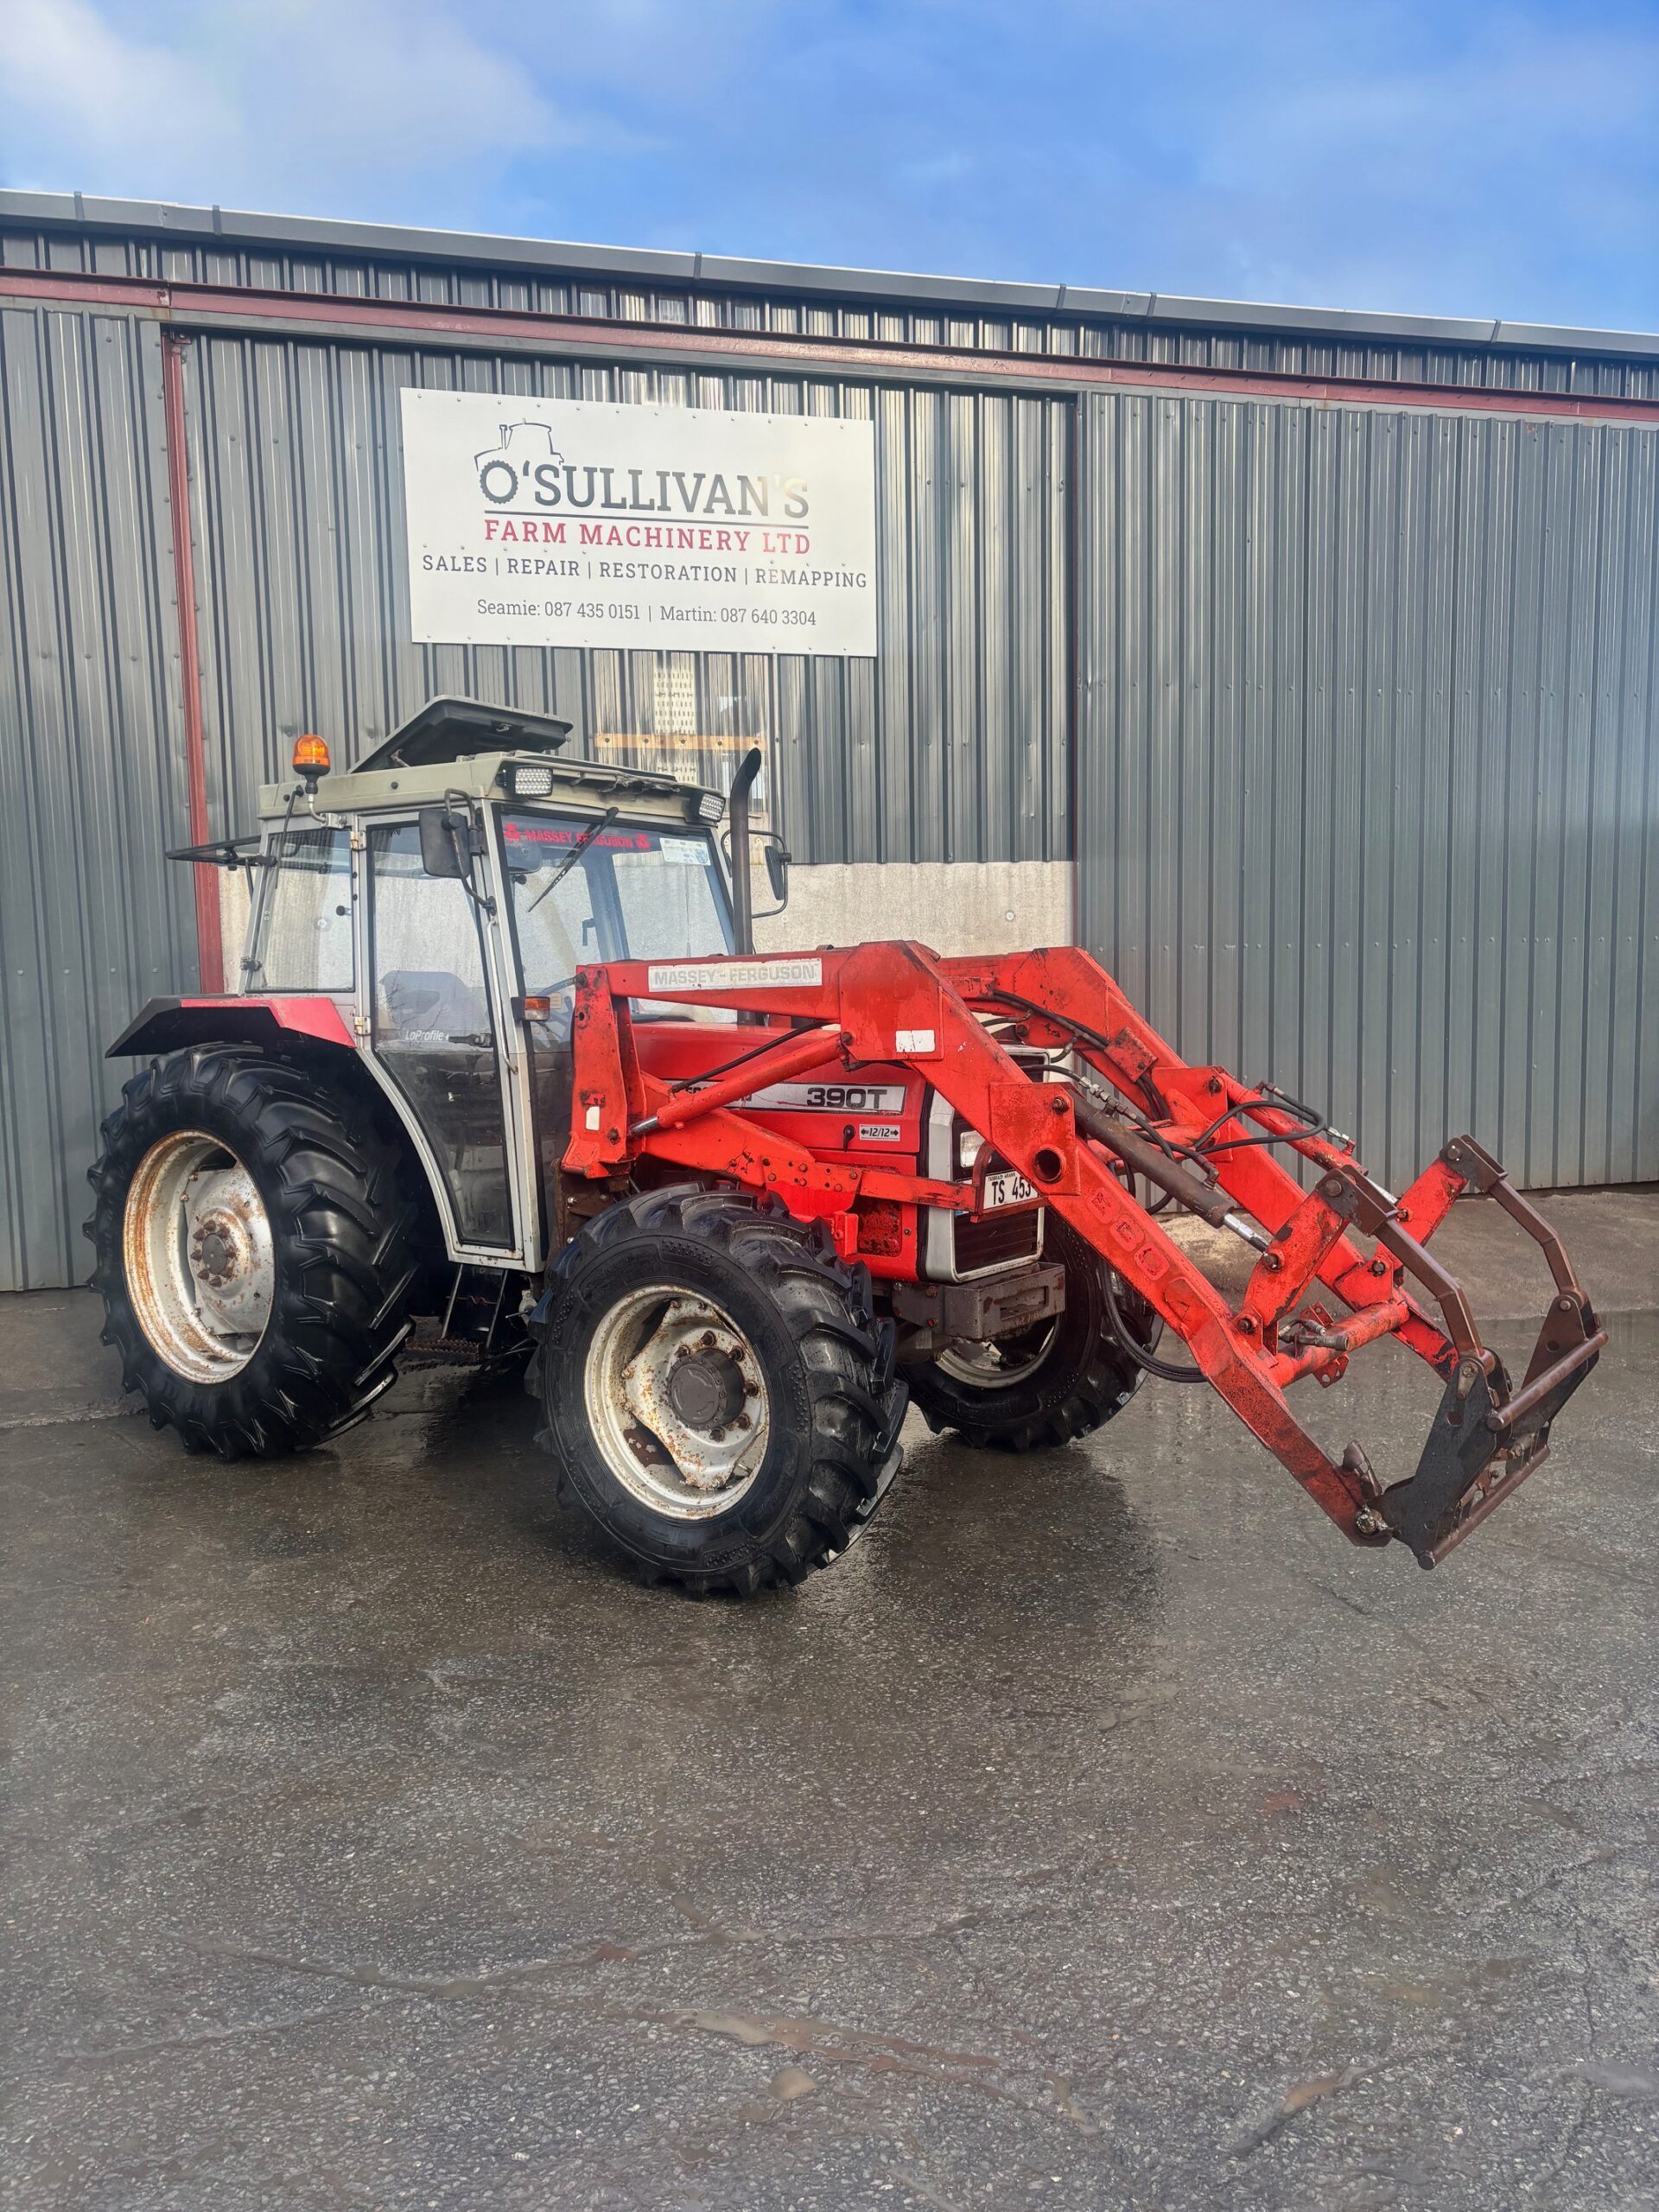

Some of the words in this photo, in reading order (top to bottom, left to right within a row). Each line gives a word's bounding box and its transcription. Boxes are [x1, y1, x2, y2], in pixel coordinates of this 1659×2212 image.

[480, 459, 809, 519] O'SULLIVAN'S
[485, 519, 568, 544] FARM
[579, 524, 751, 553] MACHINERY
[763, 531, 810, 555] LTD
[423, 554, 487, 573] SALES
[507, 557, 581, 576] REPAIR
[599, 562, 737, 583] RESTORATION
[755, 567, 867, 588] REMAPPING
[477, 598, 541, 616] Seamie:
[544, 601, 572, 618] 087
[576, 602, 604, 619] 435
[608, 603, 640, 620] 0151
[660, 605, 717, 622] Martin:
[720, 607, 747, 623] 087
[751, 608, 778, 625] 640
[781, 610, 817, 626] 3304
[525, 830, 572, 844] MASSEY
[404, 1029, 444, 1041] LoProfile
[806, 1087, 887, 1109] 390T
[869, 1127, 890, 1137] 12/12
[991, 1179, 1005, 1205] TS
